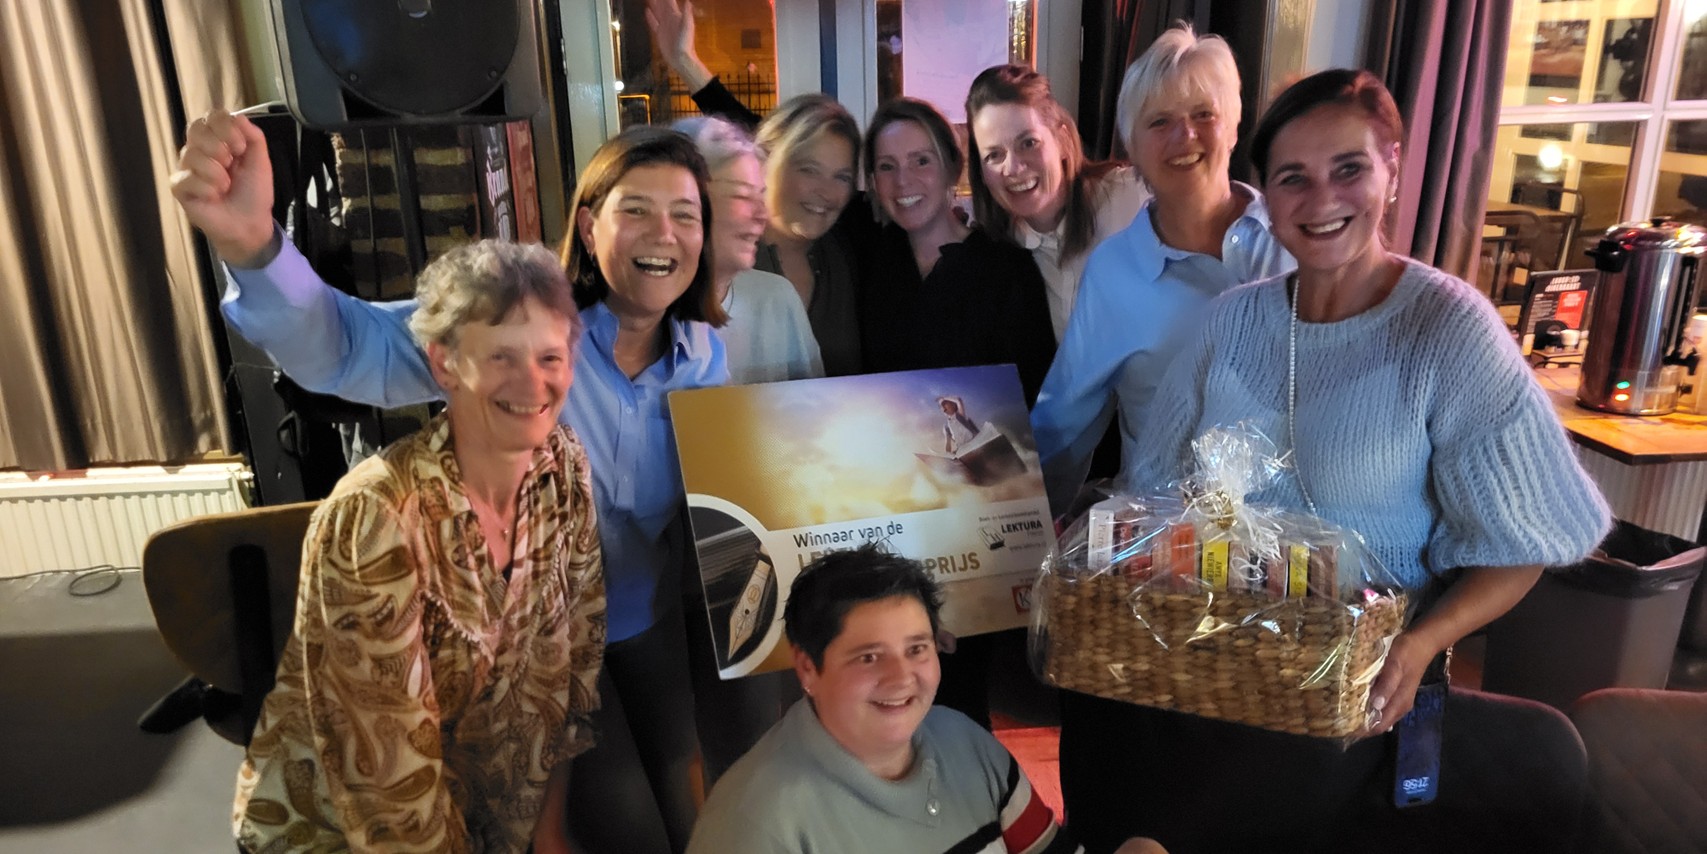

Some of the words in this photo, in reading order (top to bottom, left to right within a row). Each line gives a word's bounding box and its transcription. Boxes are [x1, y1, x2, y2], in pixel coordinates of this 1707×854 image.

[793, 529, 854, 548] Winnaar
[858, 526, 884, 539] van
[887, 521, 904, 535] de
[1001, 519, 1043, 534] LEKTURA
